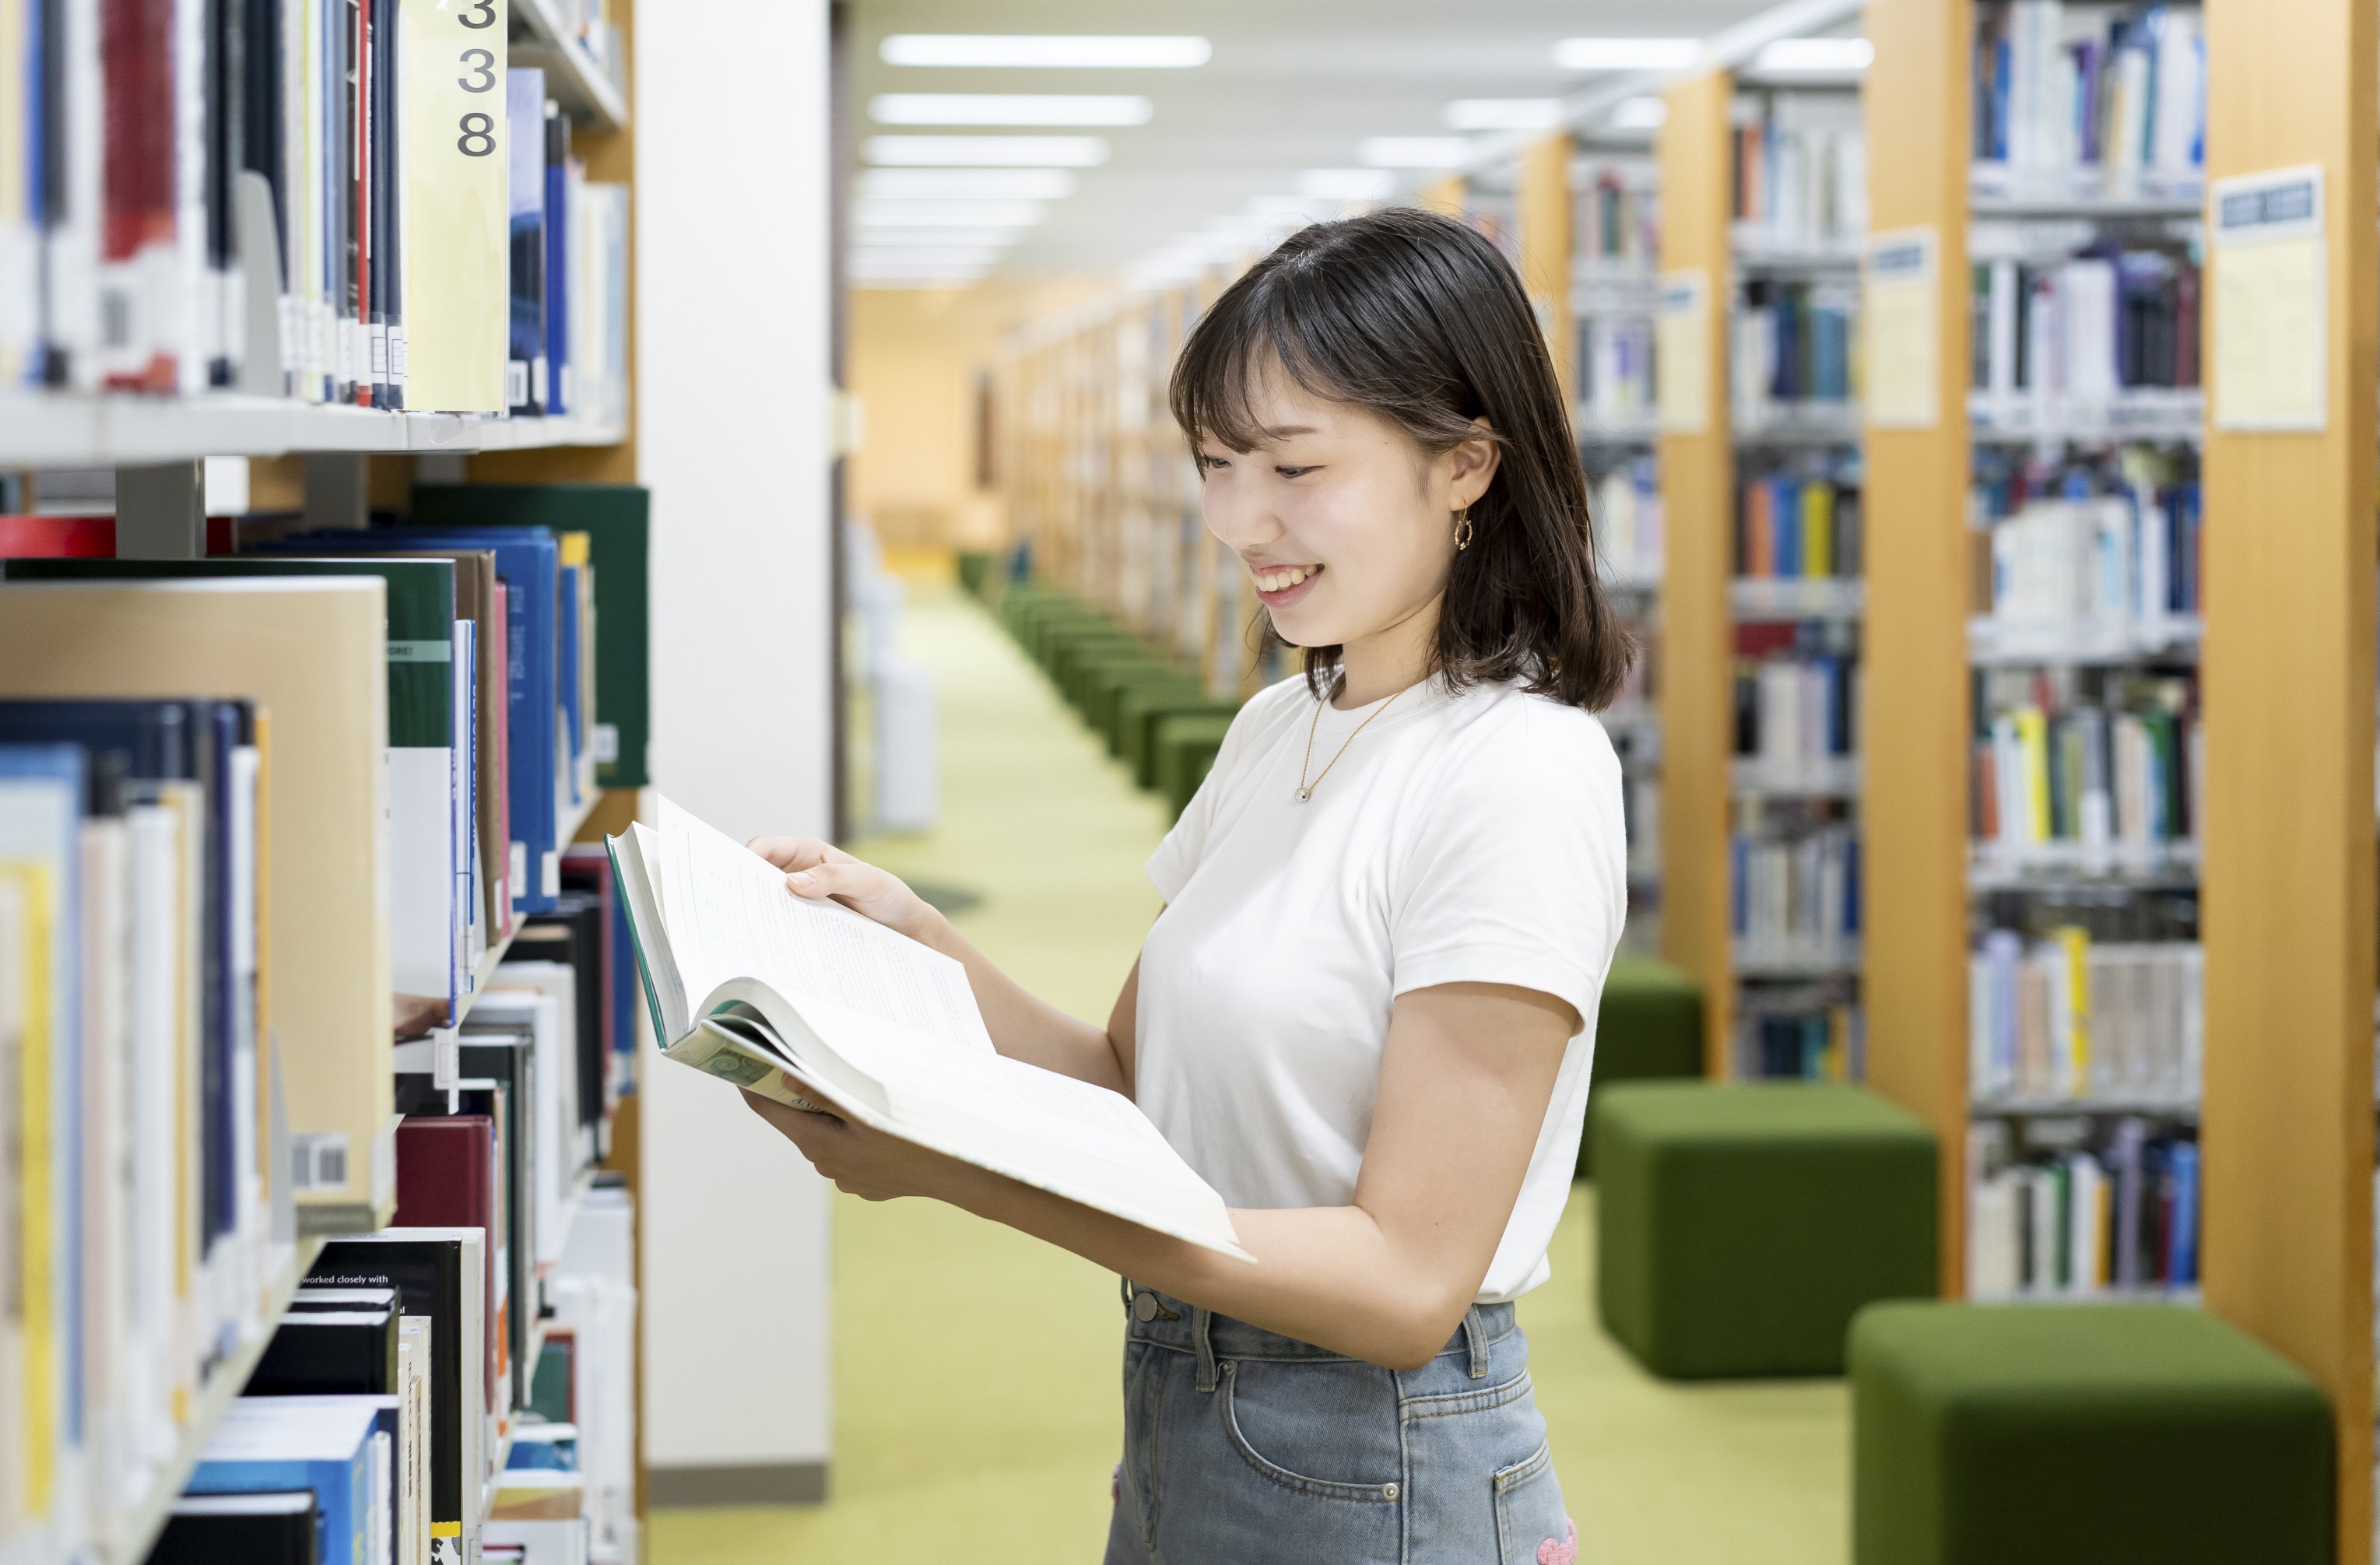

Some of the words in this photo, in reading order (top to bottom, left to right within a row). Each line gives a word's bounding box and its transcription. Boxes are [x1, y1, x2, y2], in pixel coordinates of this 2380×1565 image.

[302, 1275, 335, 1284] worked
[337, 1275, 367, 1286] closely
[368, 1275, 388, 1283] with
